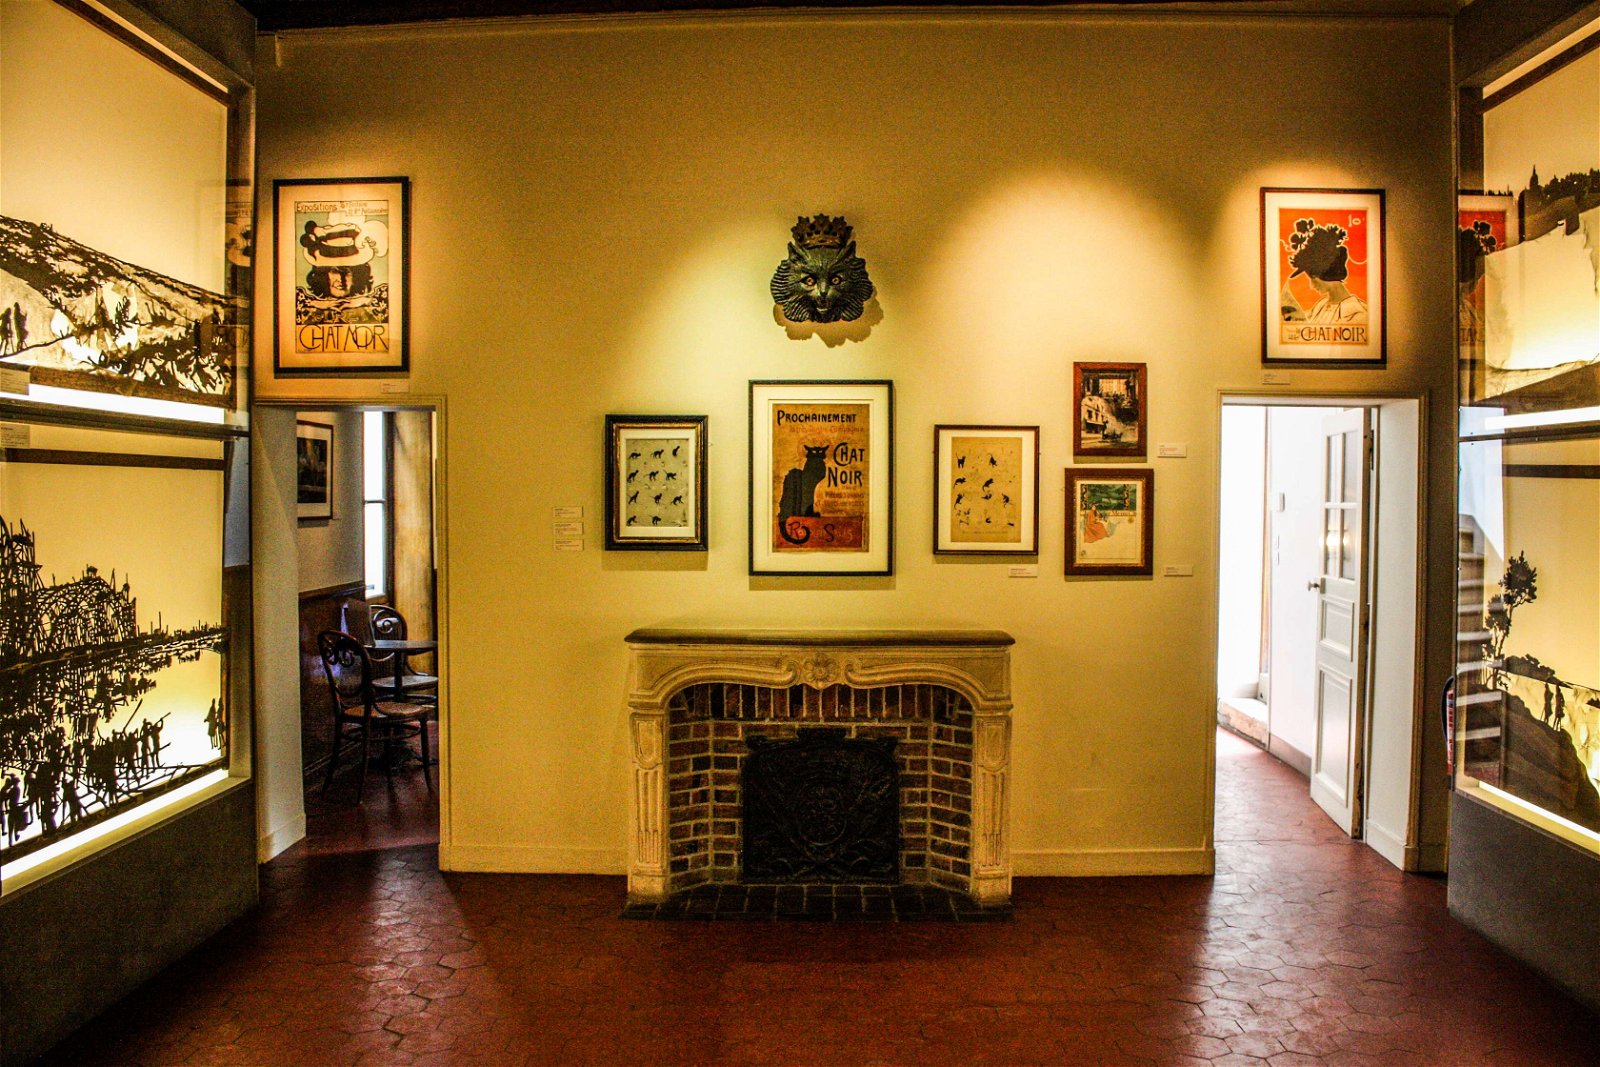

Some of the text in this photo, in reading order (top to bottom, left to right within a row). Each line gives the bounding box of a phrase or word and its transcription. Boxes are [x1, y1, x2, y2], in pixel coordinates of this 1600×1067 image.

[296, 202, 338, 213] Expositions
[300, 324, 389, 352] CHAT NOIR
[1301, 326, 1332, 341] CHAT
[1333, 326, 1367, 342] NOIR
[777, 410, 857, 426] PROCHAINEMENT
[833, 442, 865, 466] CHAT
[828, 467, 863, 487] NOIR
